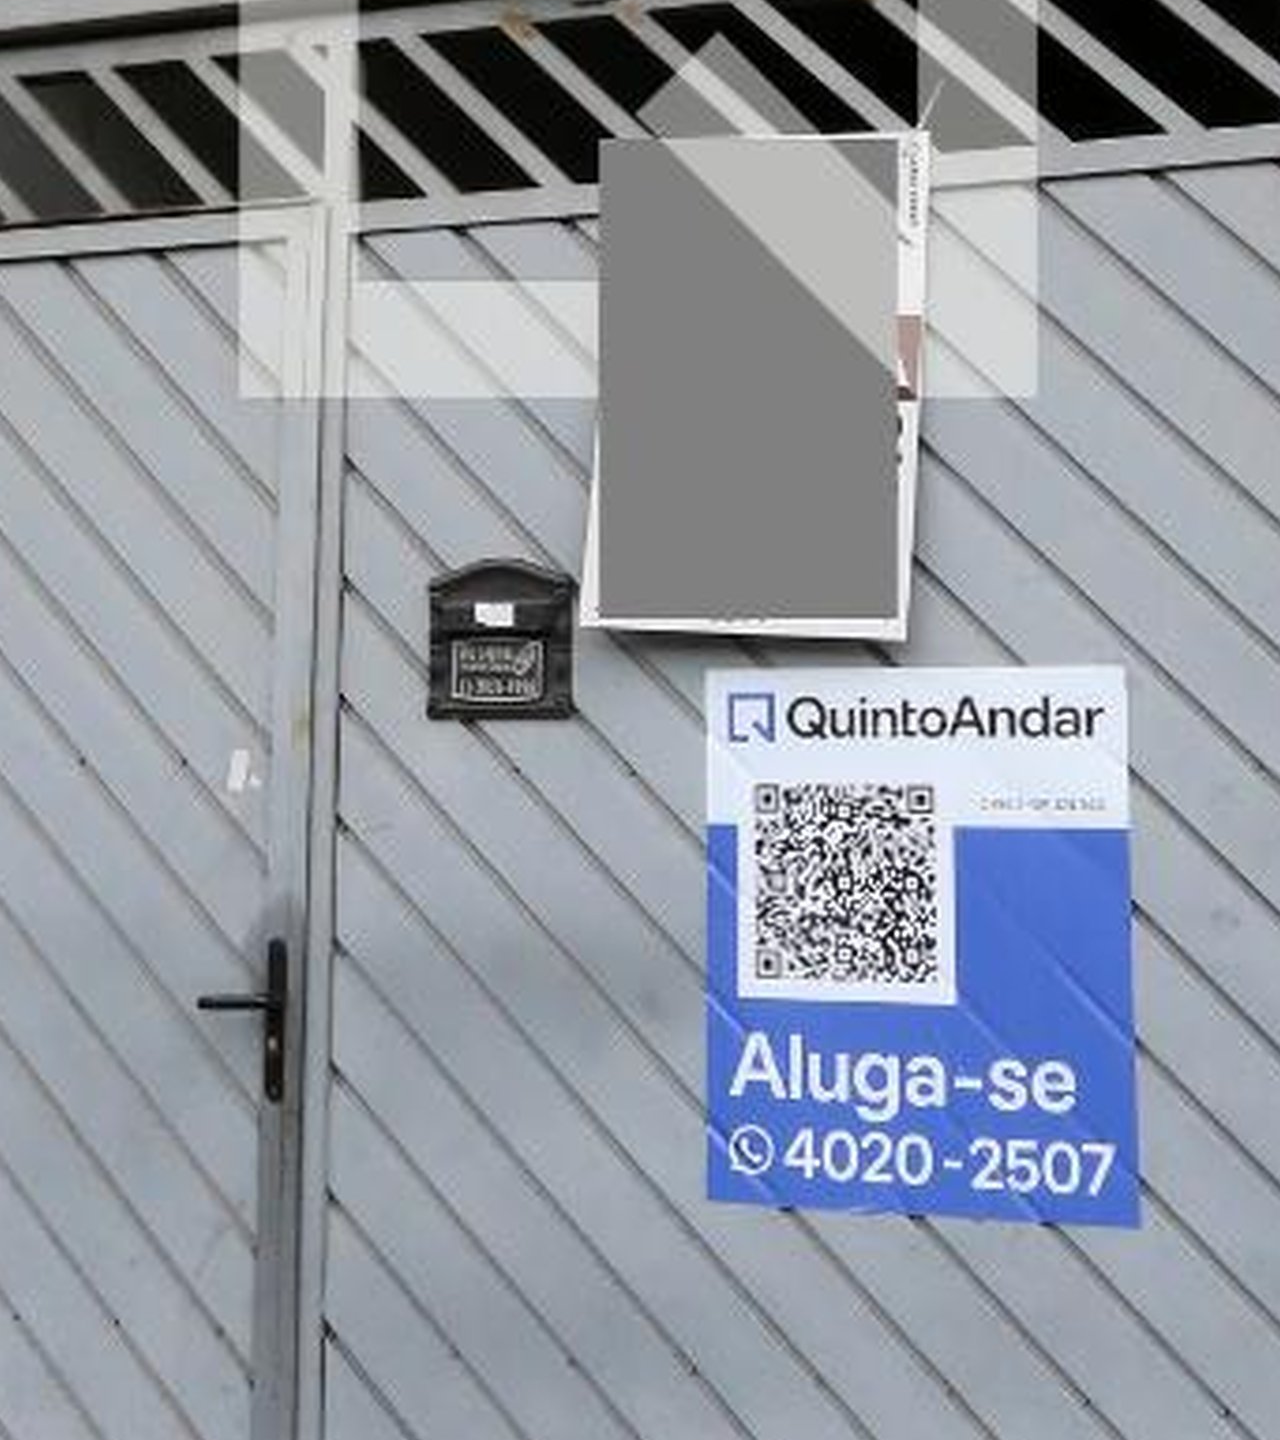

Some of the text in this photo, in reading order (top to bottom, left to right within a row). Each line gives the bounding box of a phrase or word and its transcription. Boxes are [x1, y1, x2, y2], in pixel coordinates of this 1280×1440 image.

[785, 695, 1104, 743] QuintoAndar
[729, 1032, 1076, 1120] Aluga-se
[783, 1132, 1116, 1196] 4020-2507
